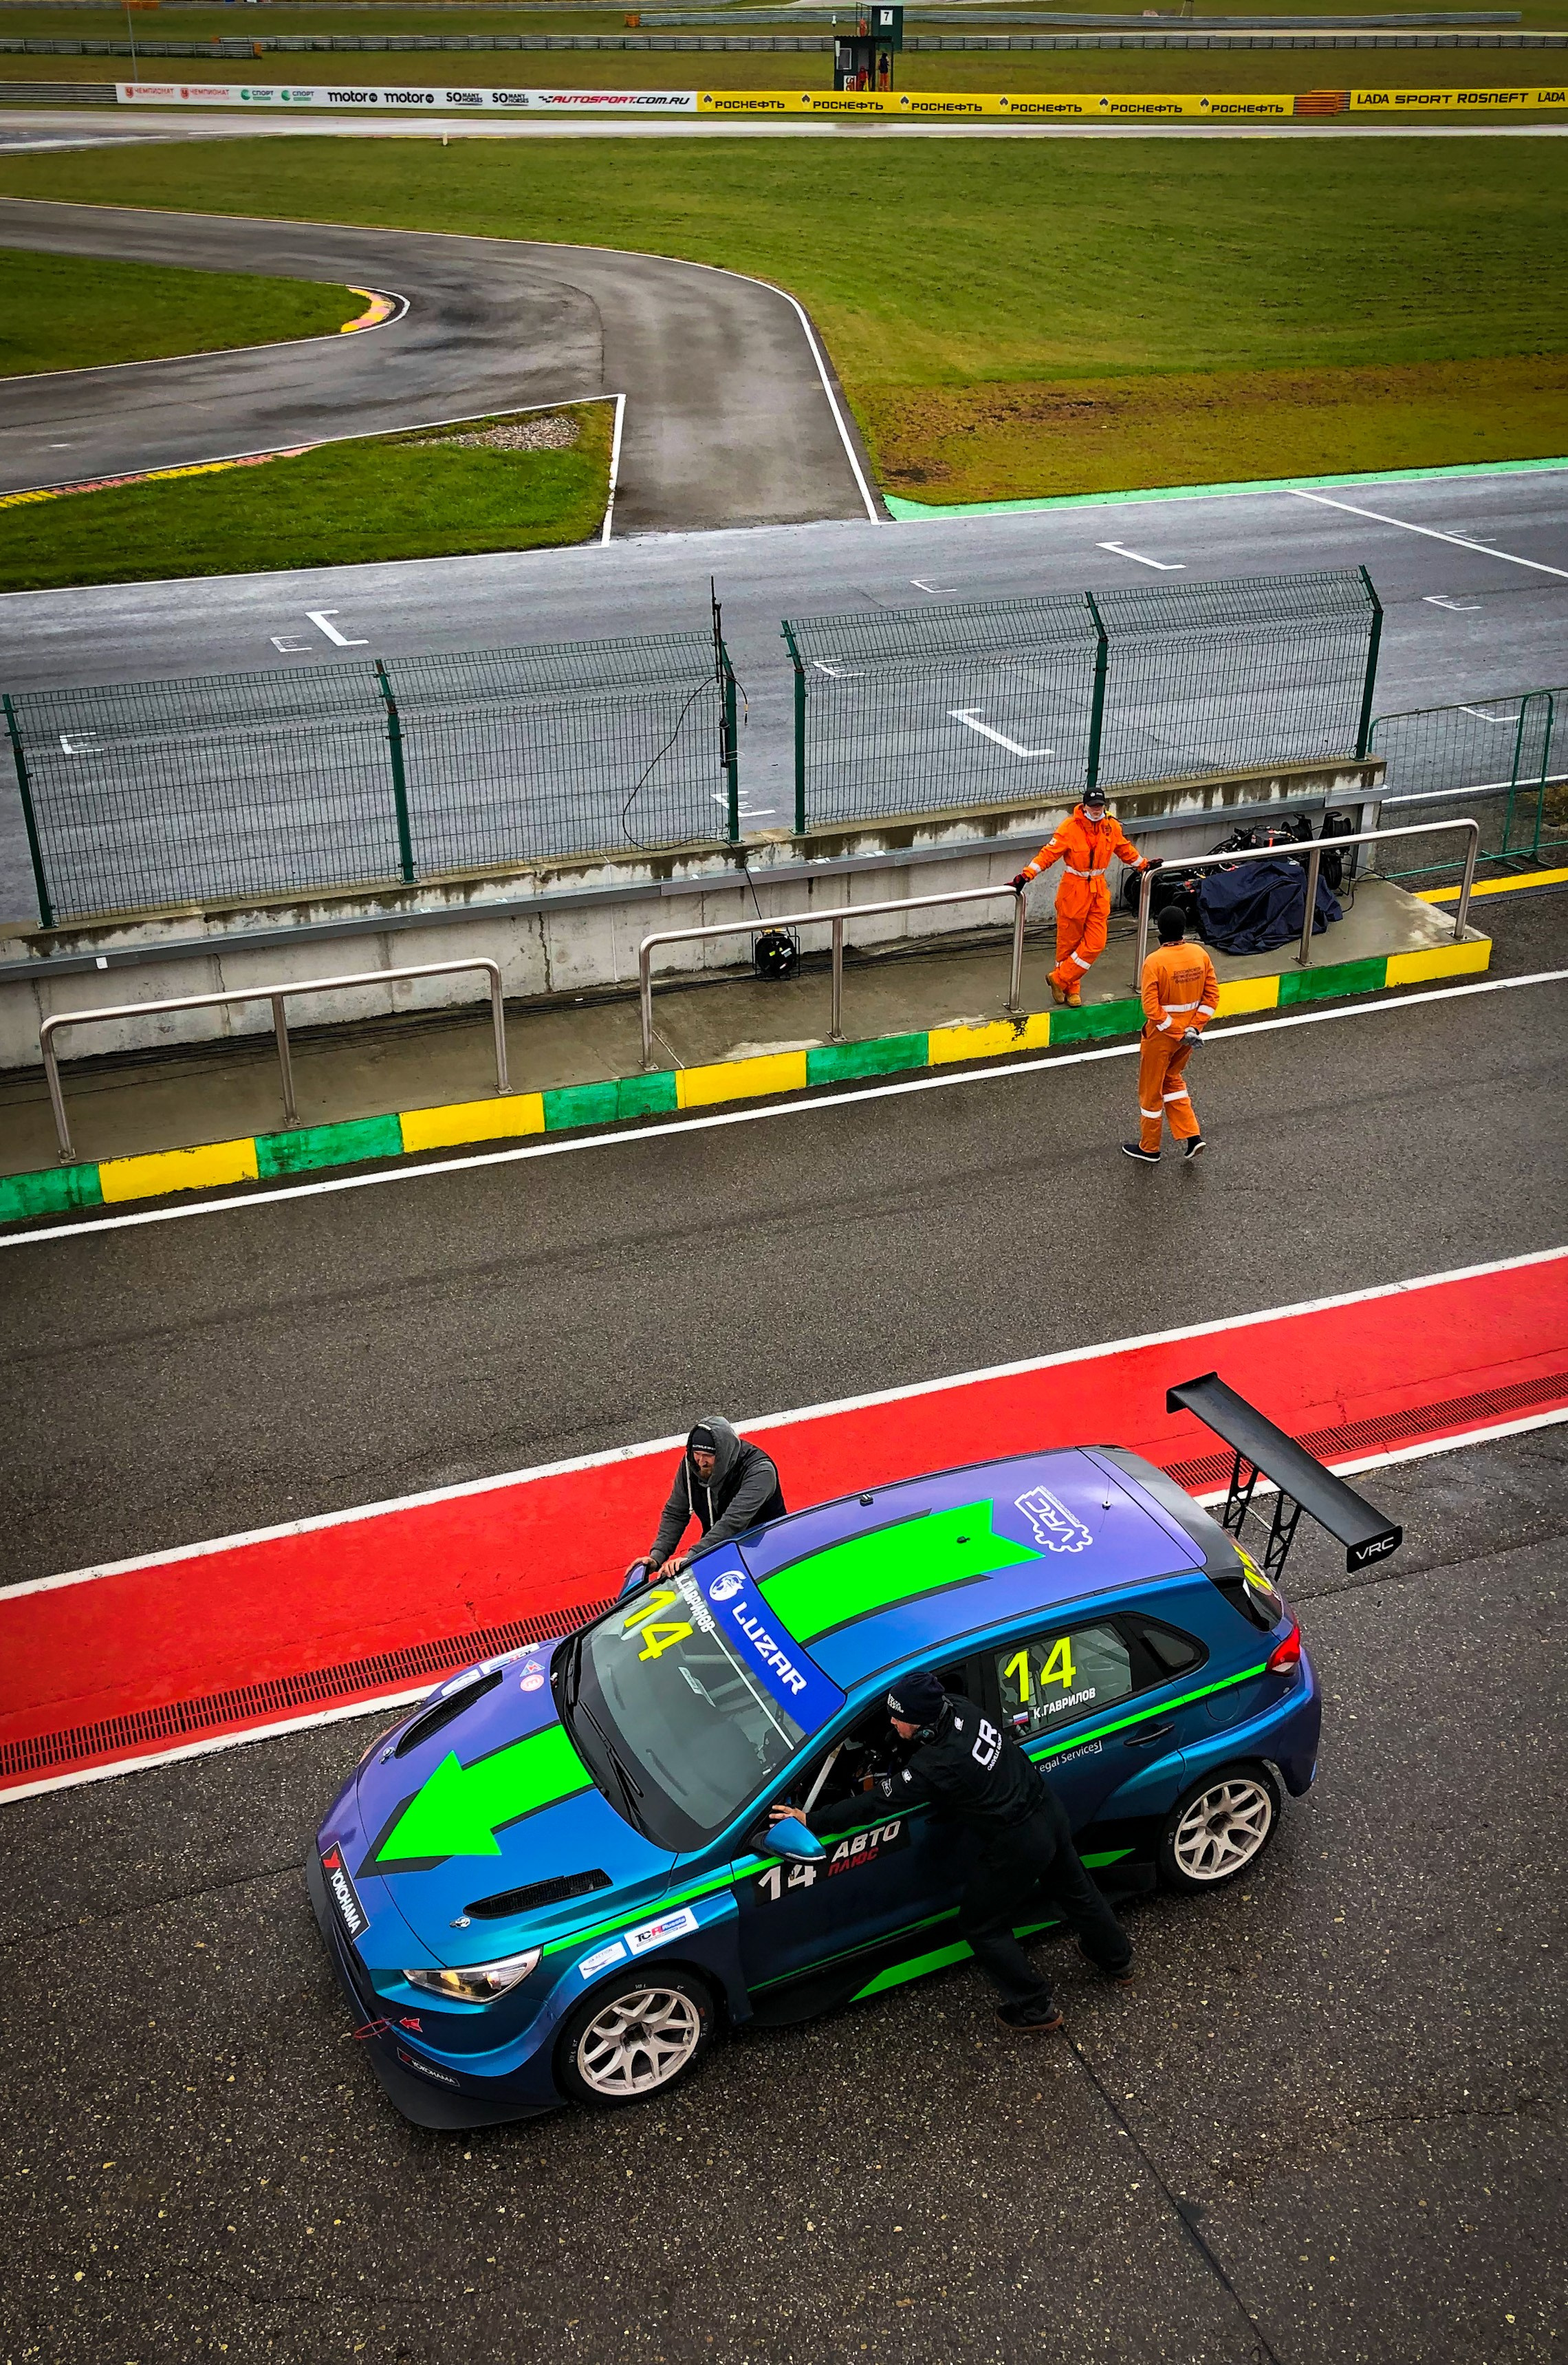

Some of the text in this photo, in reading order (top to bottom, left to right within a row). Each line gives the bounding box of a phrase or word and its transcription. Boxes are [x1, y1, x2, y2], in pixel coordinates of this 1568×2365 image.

[884, 11, 889, 21] 7
[328, 91, 367, 102] motor
[384, 91, 424, 102] motor
[446, 92, 461, 102] SO
[492, 93, 508, 102] SO
[552, 96, 689, 105] AUTOSPORT.COM.RU
[715, 100, 785, 109] РОСНЕФТЬ
[1357, 92, 1566, 104] LADA SPORT ROSNEFT LADA
[813, 101, 884, 110] РОСНЕФТЬ
[911, 102, 983, 111] РОСНЕФТЬ
[1010, 104, 1082, 113] РОСНЕФТЬ
[1110, 104, 1183, 113] РОСНЕФТЬ
[1211, 104, 1284, 113] РОСНЕФТЬ
[1025, 1498, 1075, 1543] VRC
[1355, 1536, 1394, 1559] VRC
[624, 1590, 693, 1661] 14
[732, 1601, 807, 1696] LUZAR
[1003, 1637, 1076, 1703] 14
[1033, 1687, 1096, 1720] К.ГАВРИЛОВ
[972, 1718, 998, 1765] CR
[1034, 1742, 1099, 1773] egal Services
[831, 1821, 901, 1863] АВТО
[827, 1847, 879, 1877] ПЛЮС
[758, 1864, 816, 1901] 14
[331, 1868, 361, 1934] YOKOHAMA
[635, 1925, 663, 1942] TCR
[412, 2060, 455, 2084] YOKOHAMA
